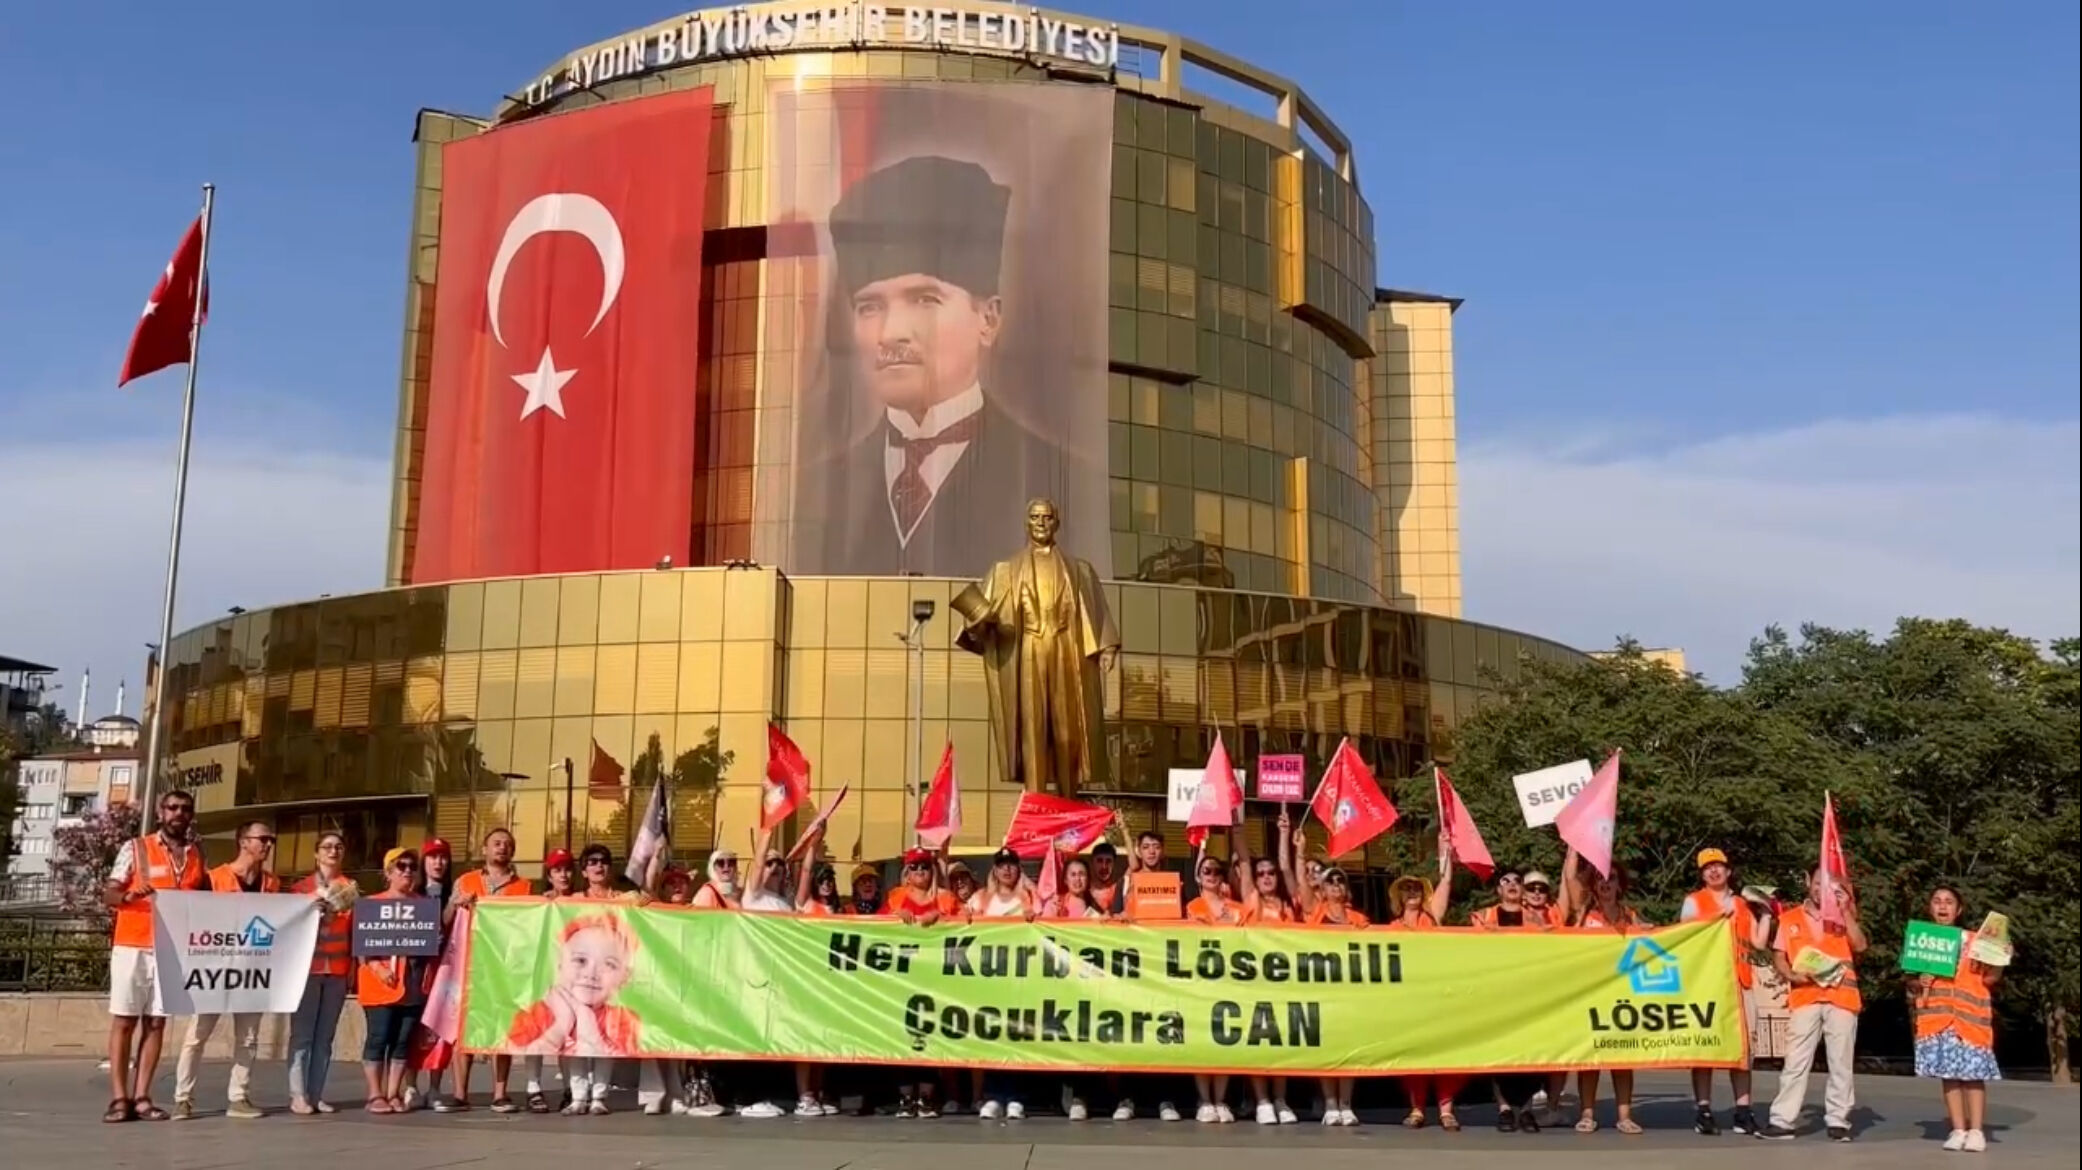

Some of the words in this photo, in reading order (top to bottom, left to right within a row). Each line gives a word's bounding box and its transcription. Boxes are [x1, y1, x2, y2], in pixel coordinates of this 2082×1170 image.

[566, 35, 648, 90] AYDIN
[904, 6, 1119, 66] BELEDİYESİ
[380, 901, 415, 920] BİZ
[188, 929, 250, 947] LÖSEV
[364, 936, 393, 947] İZMİR
[395, 936, 427, 947] LÖSEV
[1909, 932, 1956, 953] LÖSEV
[828, 931, 920, 974] Her
[942, 935, 1141, 979] Kurban
[1165, 939, 1403, 984] Lösemili
[184, 967, 272, 991] AYDIN
[905, 993, 1185, 1051] Çocuklara
[1210, 1000, 1321, 1047] CAN
[1588, 999, 1717, 1032] LÖSEV
